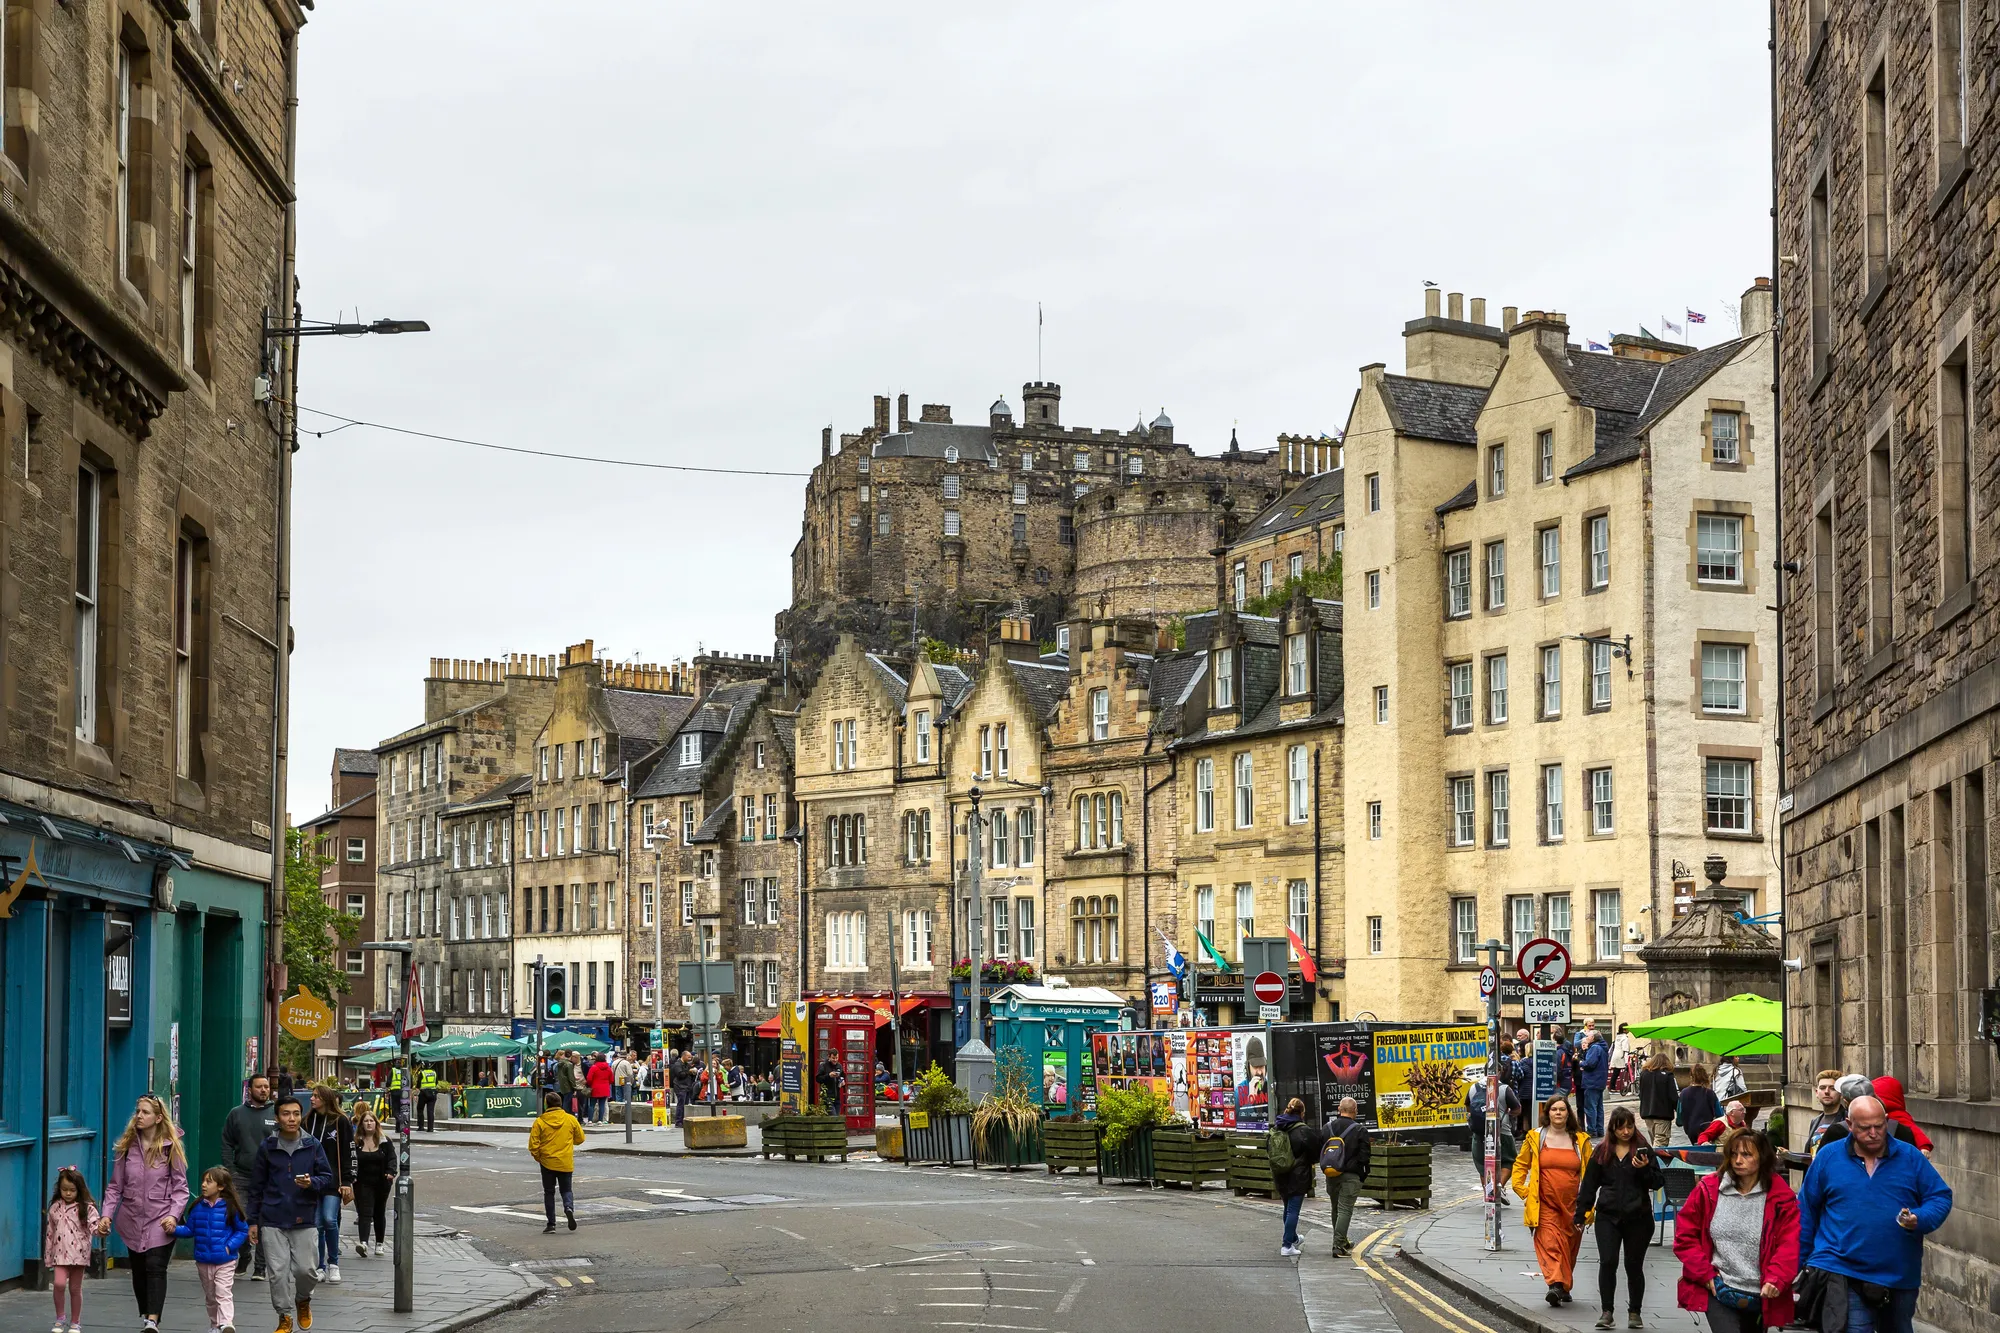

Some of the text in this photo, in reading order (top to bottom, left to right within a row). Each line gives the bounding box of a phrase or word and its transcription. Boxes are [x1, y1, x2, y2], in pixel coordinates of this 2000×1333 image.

[1482, 974, 1493, 986] 20
[1502, 985, 1515, 995] THE
[1572, 985, 1597, 995] HOTEL
[1154, 995, 1168, 1005] 220
[1528, 998, 1565, 1007] Except
[289, 1008, 312, 1017] FISH
[1530, 1009, 1564, 1018] cycles
[288, 1017, 318, 1028] CHIPS
[1376, 1034, 1409, 1045] FREEDOM
[1409, 1033, 1433, 1044] BALLET
[1436, 1032, 1443, 1042] OF
[1446, 1030, 1476, 1041] UKRAINE
[1377, 1041, 1487, 1063] BALLET FREEDOM
[1326, 1083, 1371, 1093] ANTIGONE,
[486, 1096, 522, 1109] BIDDY'S
